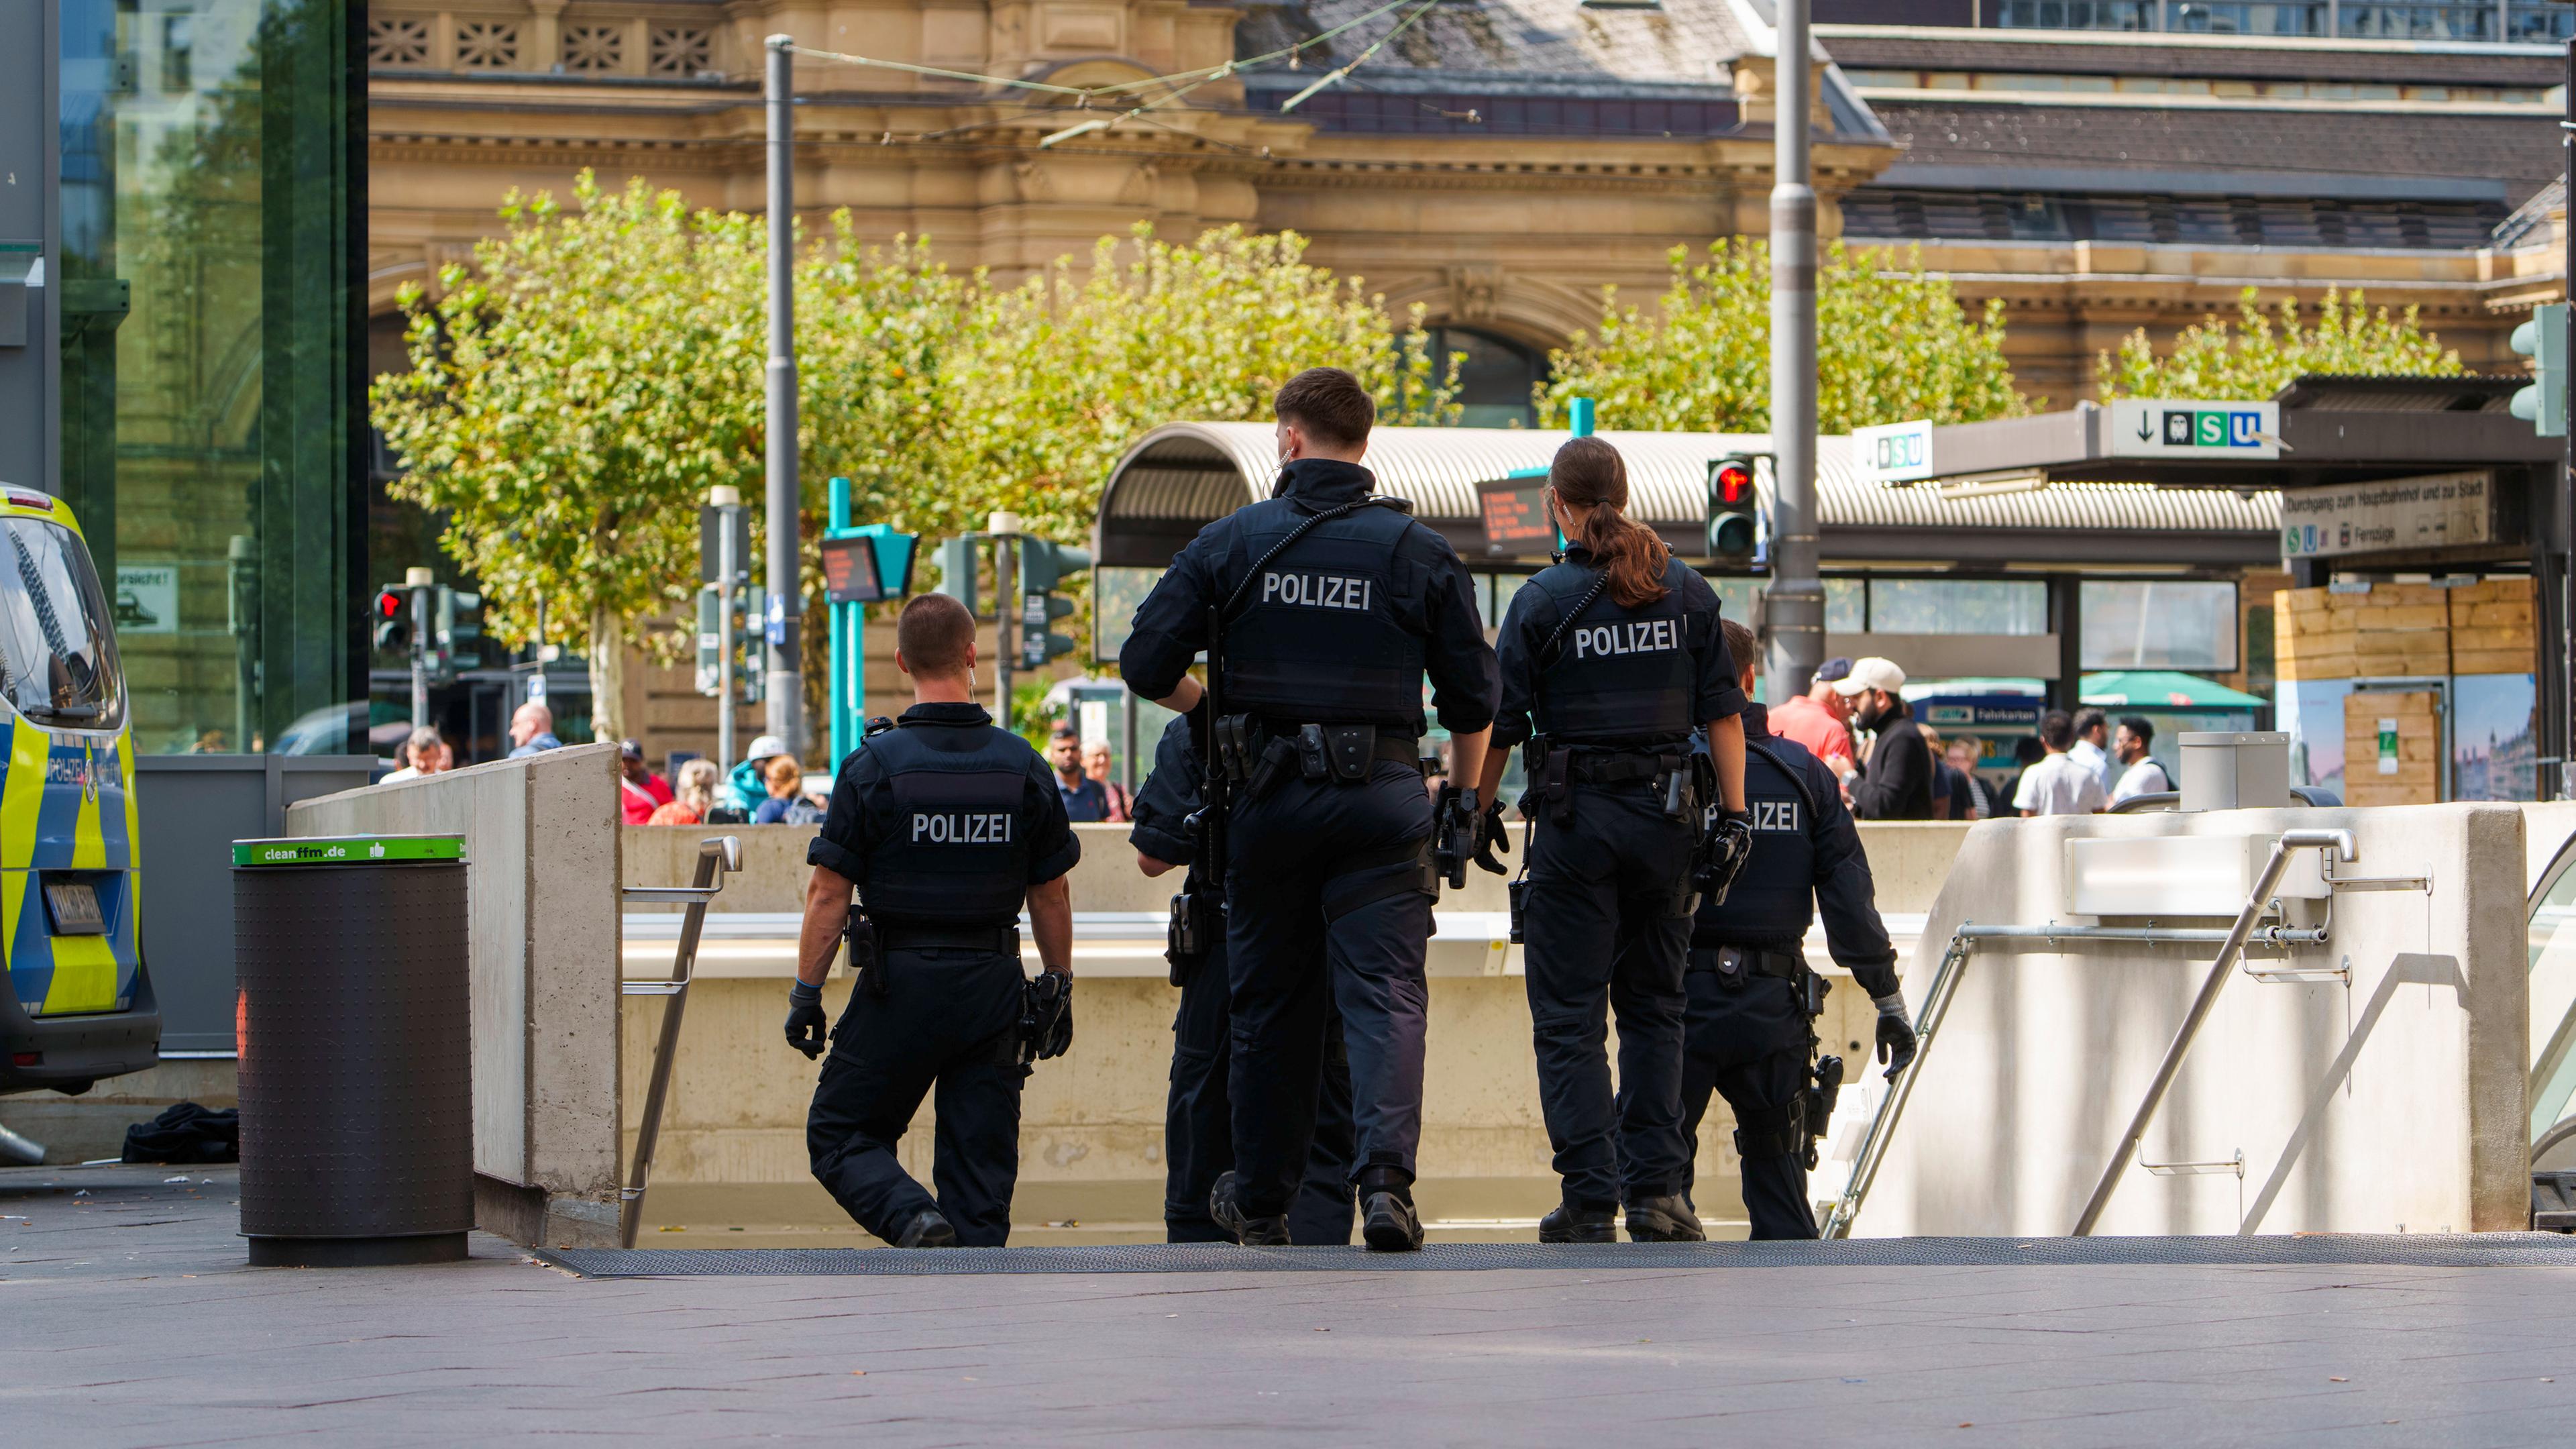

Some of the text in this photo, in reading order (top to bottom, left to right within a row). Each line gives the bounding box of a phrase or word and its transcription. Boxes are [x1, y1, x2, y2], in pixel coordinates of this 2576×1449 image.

[2201, 415, 2256, 444] S U
[1894, 435, 1921, 465] S U
[2287, 479, 2484, 514] Durchgang zum Hauptbahnhof und zur Stadt
[2355, 525, 2395, 543] Fernzüge
[1263, 572, 1371, 610] POLIZEI
[1575, 619, 1678, 659] POLIZEI
[912, 814, 1011, 843] POLIZEI
[1704, 802, 1798, 830] PIZEI
[265, 846, 345, 860] cleanffm.de
